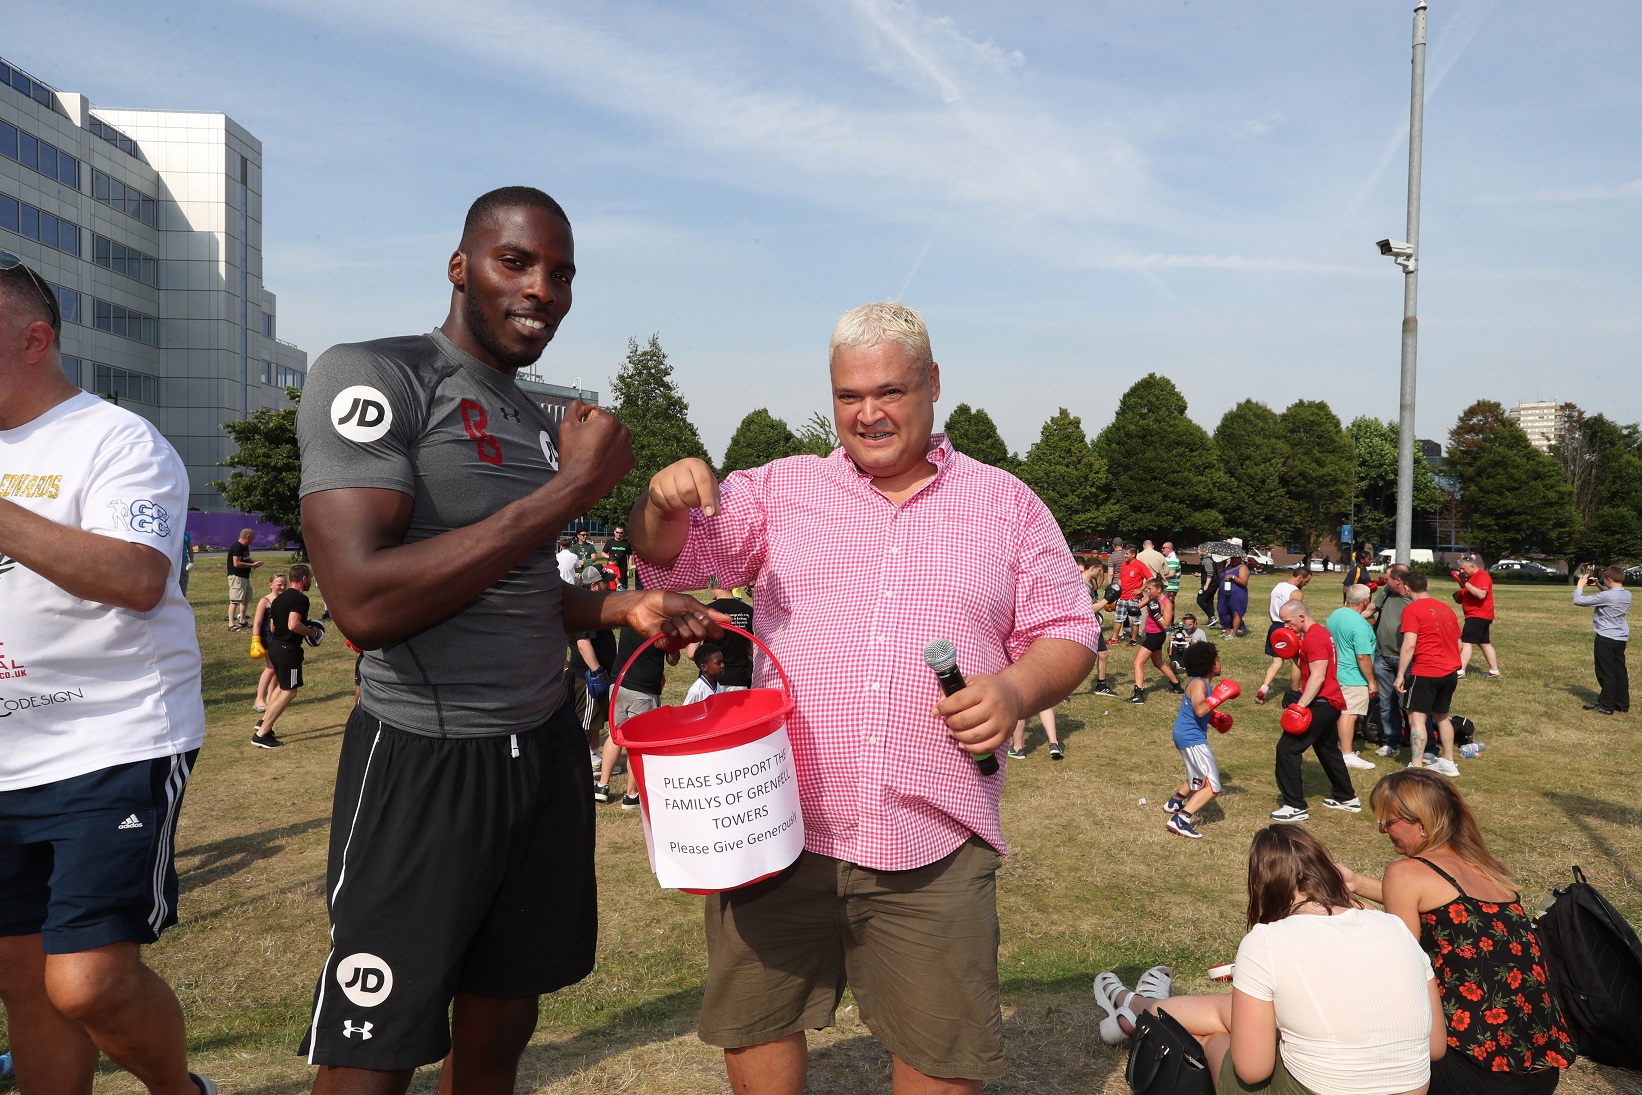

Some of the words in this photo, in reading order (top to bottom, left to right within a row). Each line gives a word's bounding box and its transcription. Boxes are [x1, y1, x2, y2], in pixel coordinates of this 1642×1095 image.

[337, 397, 386, 428] JD
[663, 775, 712, 790] PLEASE
[715, 757, 772, 786] SUPPORT
[773, 747, 787, 766] THE
[664, 795, 722, 811] FAMILYS
[725, 790, 744, 806] OF
[747, 768, 791, 800] GRENFELL
[117, 822, 144, 830] adidas
[711, 804, 770, 830] TOWERS
[669, 841, 710, 855] Please
[713, 839, 745, 853] Give
[344, 967, 386, 994] JD
